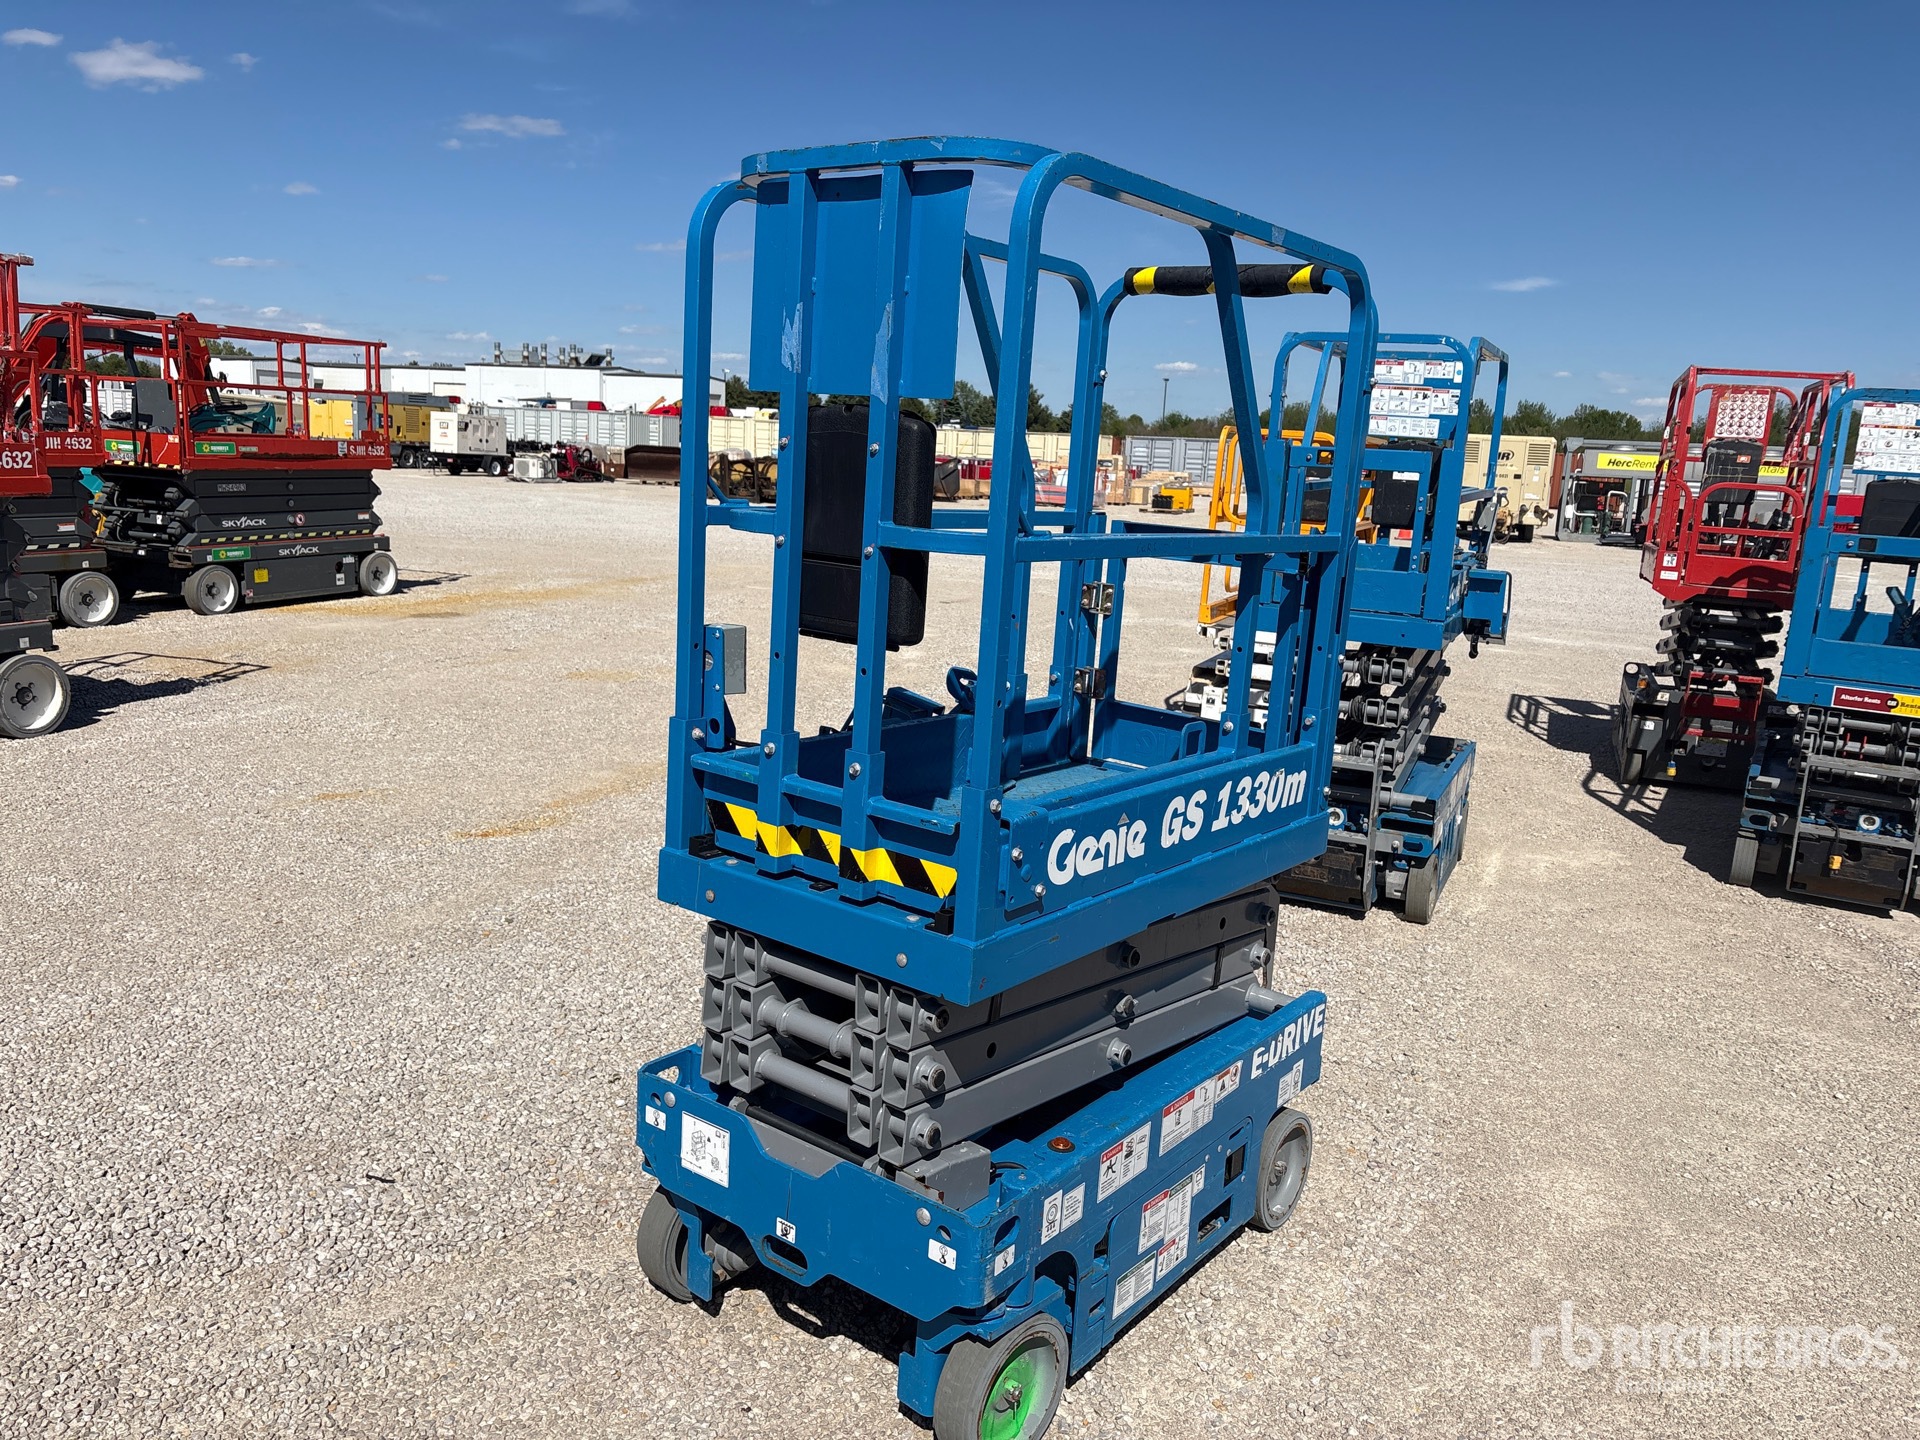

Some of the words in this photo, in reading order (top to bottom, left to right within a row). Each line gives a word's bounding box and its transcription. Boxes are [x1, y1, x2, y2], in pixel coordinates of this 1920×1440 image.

[65, 437, 92, 449] 4632
[0, 450, 33, 469] 632
[221, 516, 267, 528] SKYJACK
[278, 544, 320, 556] SKYJACK
[1047, 812, 1147, 886] Genie
[1160, 789, 1207, 849] GS
[1211, 767, 1308, 832] 1330m
[1251, 1003, 1326, 1080] E-DRIVE
